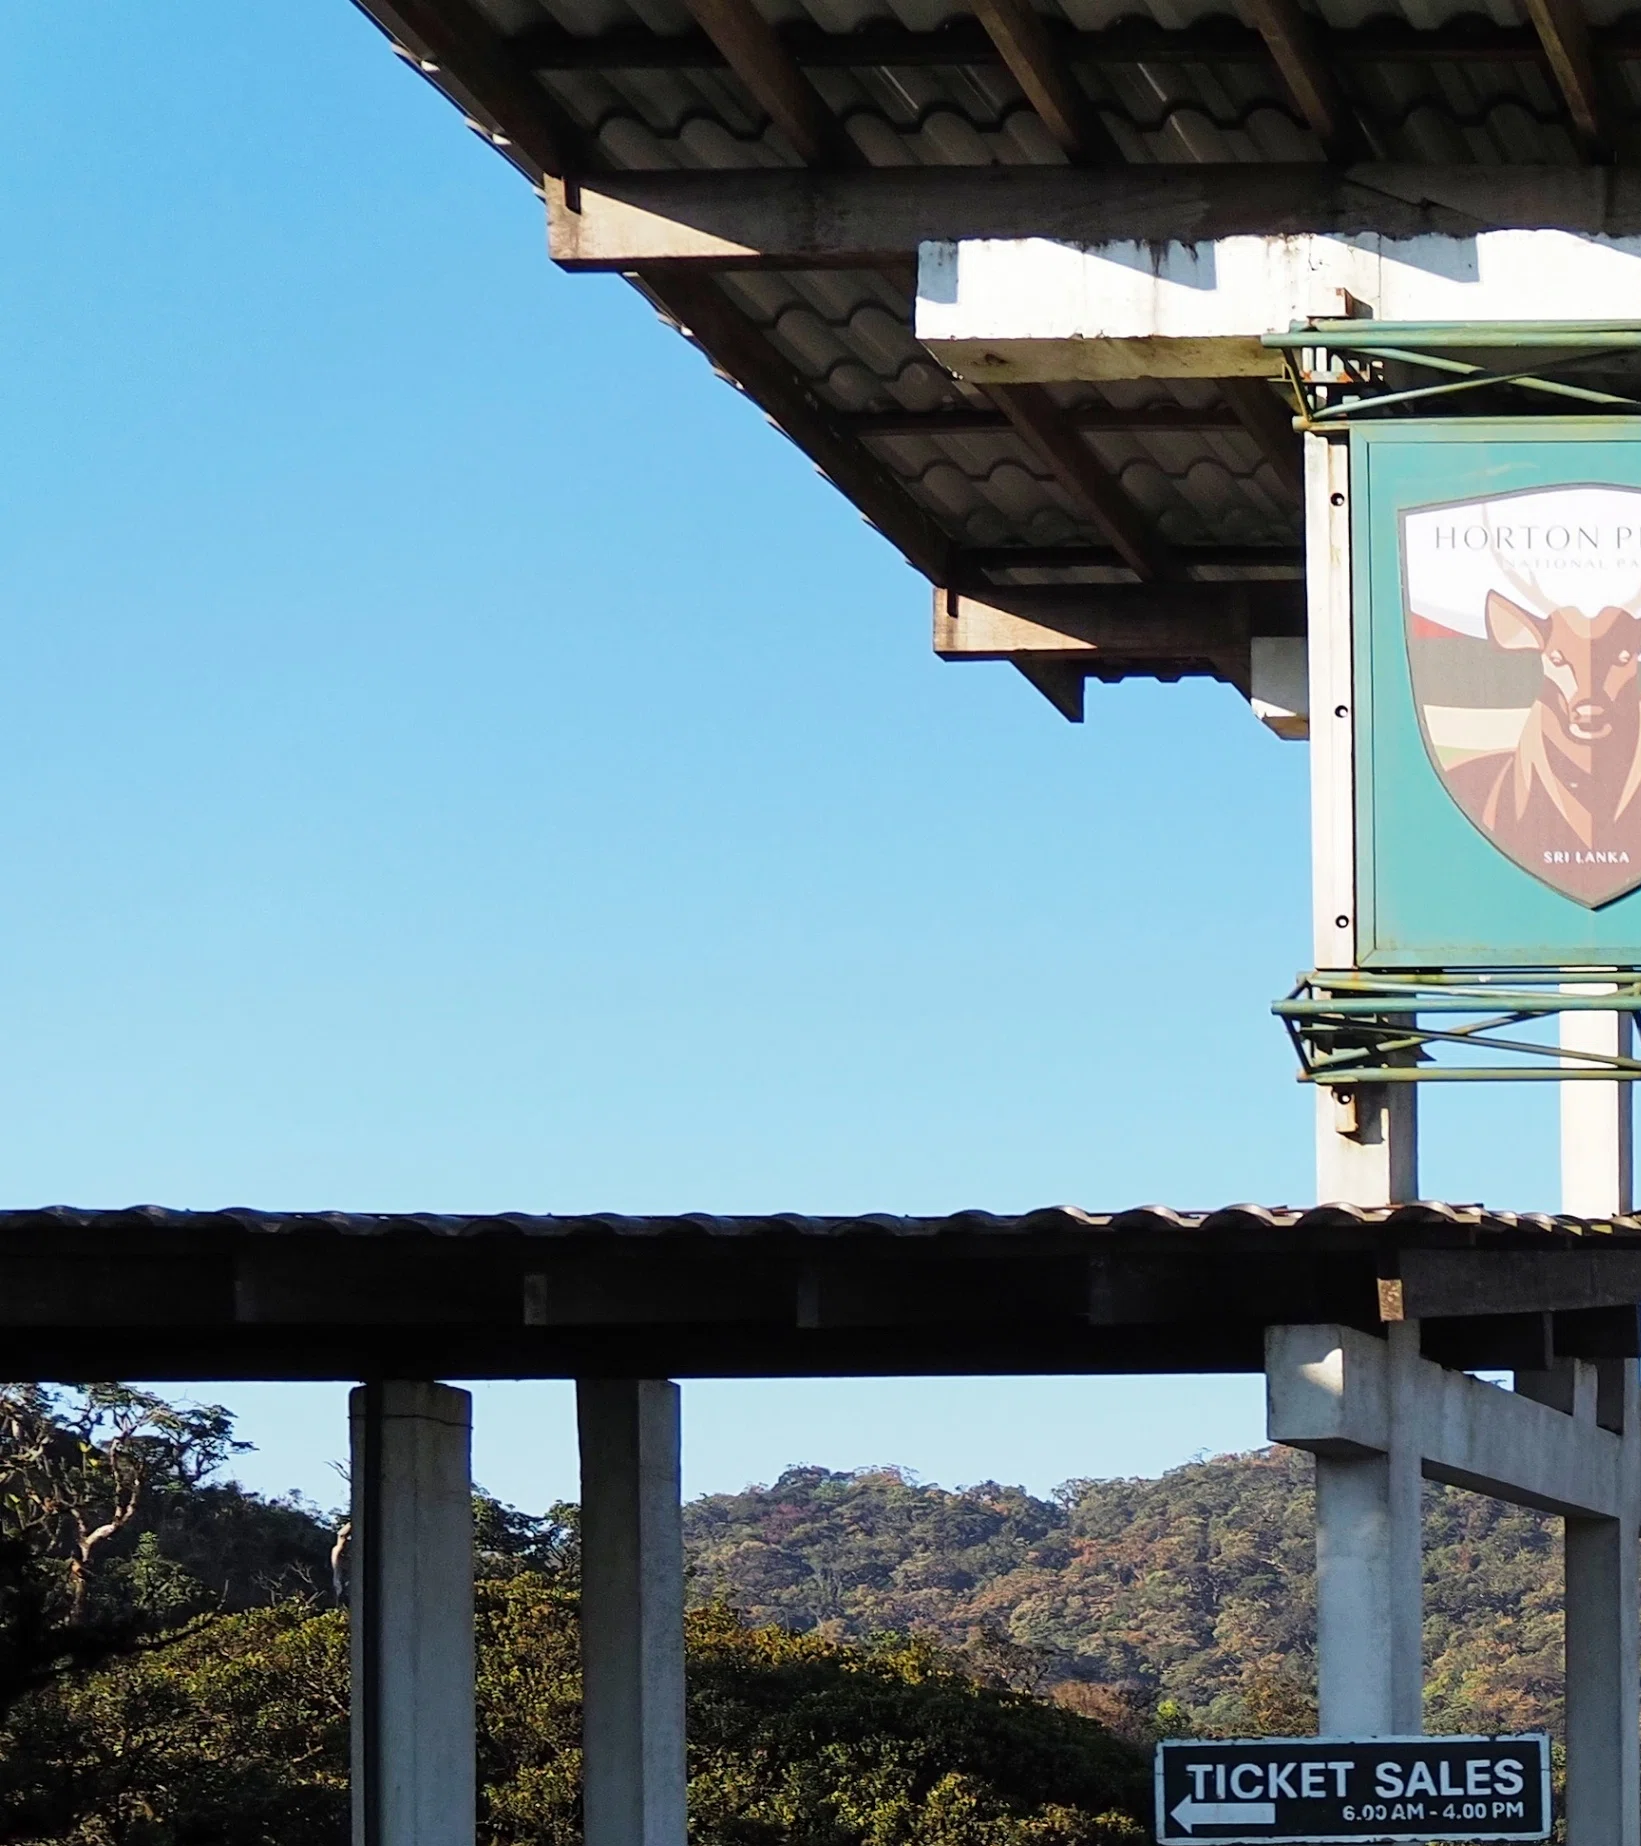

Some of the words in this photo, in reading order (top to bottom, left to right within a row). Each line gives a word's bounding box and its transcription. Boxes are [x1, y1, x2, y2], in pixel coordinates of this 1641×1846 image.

[1435, 525, 1599, 550] HORTON
[1543, 850, 1570, 864] SRI
[1575, 850, 1630, 864] LANKA
[1187, 1760, 1355, 1801] TICKET
[1374, 1757, 1525, 1799] SALES
[1342, 1804, 1387, 1822] 6.00
[1391, 1803, 1425, 1821] AM
[1442, 1803, 1487, 1820] 4.00
[1492, 1801, 1525, 1819] PM
